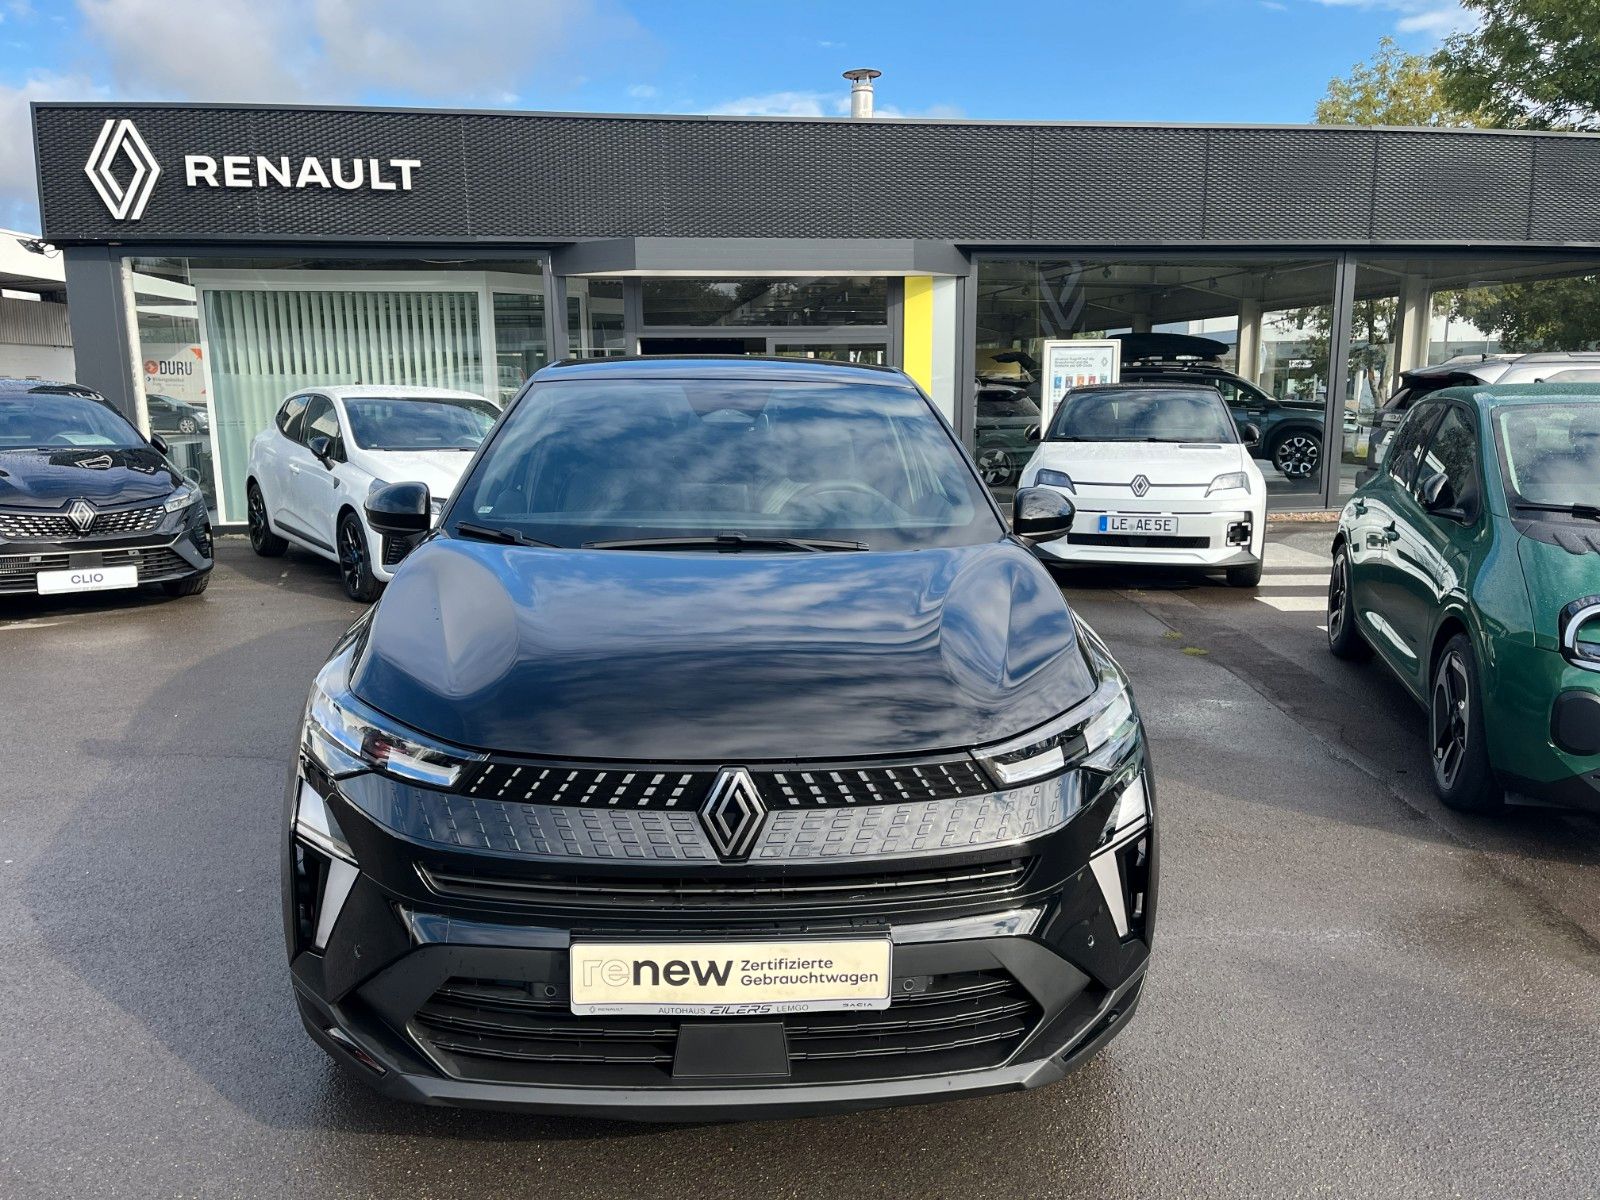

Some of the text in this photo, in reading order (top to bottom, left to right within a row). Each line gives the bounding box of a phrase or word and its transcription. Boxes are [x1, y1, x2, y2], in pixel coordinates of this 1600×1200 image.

[184, 154, 421, 190] RENAULT
[159, 360, 193, 376] DURU
[1111, 518, 1128, 531] LE
[71, 573, 104, 584] CLIO
[740, 957, 834, 972] Zertifizierte
[583, 958, 733, 987] renew
[740, 972, 879, 986] Gebrauchtwagen
[658, 1004, 809, 1015] AUTOHAUS EILERS LEMGO
